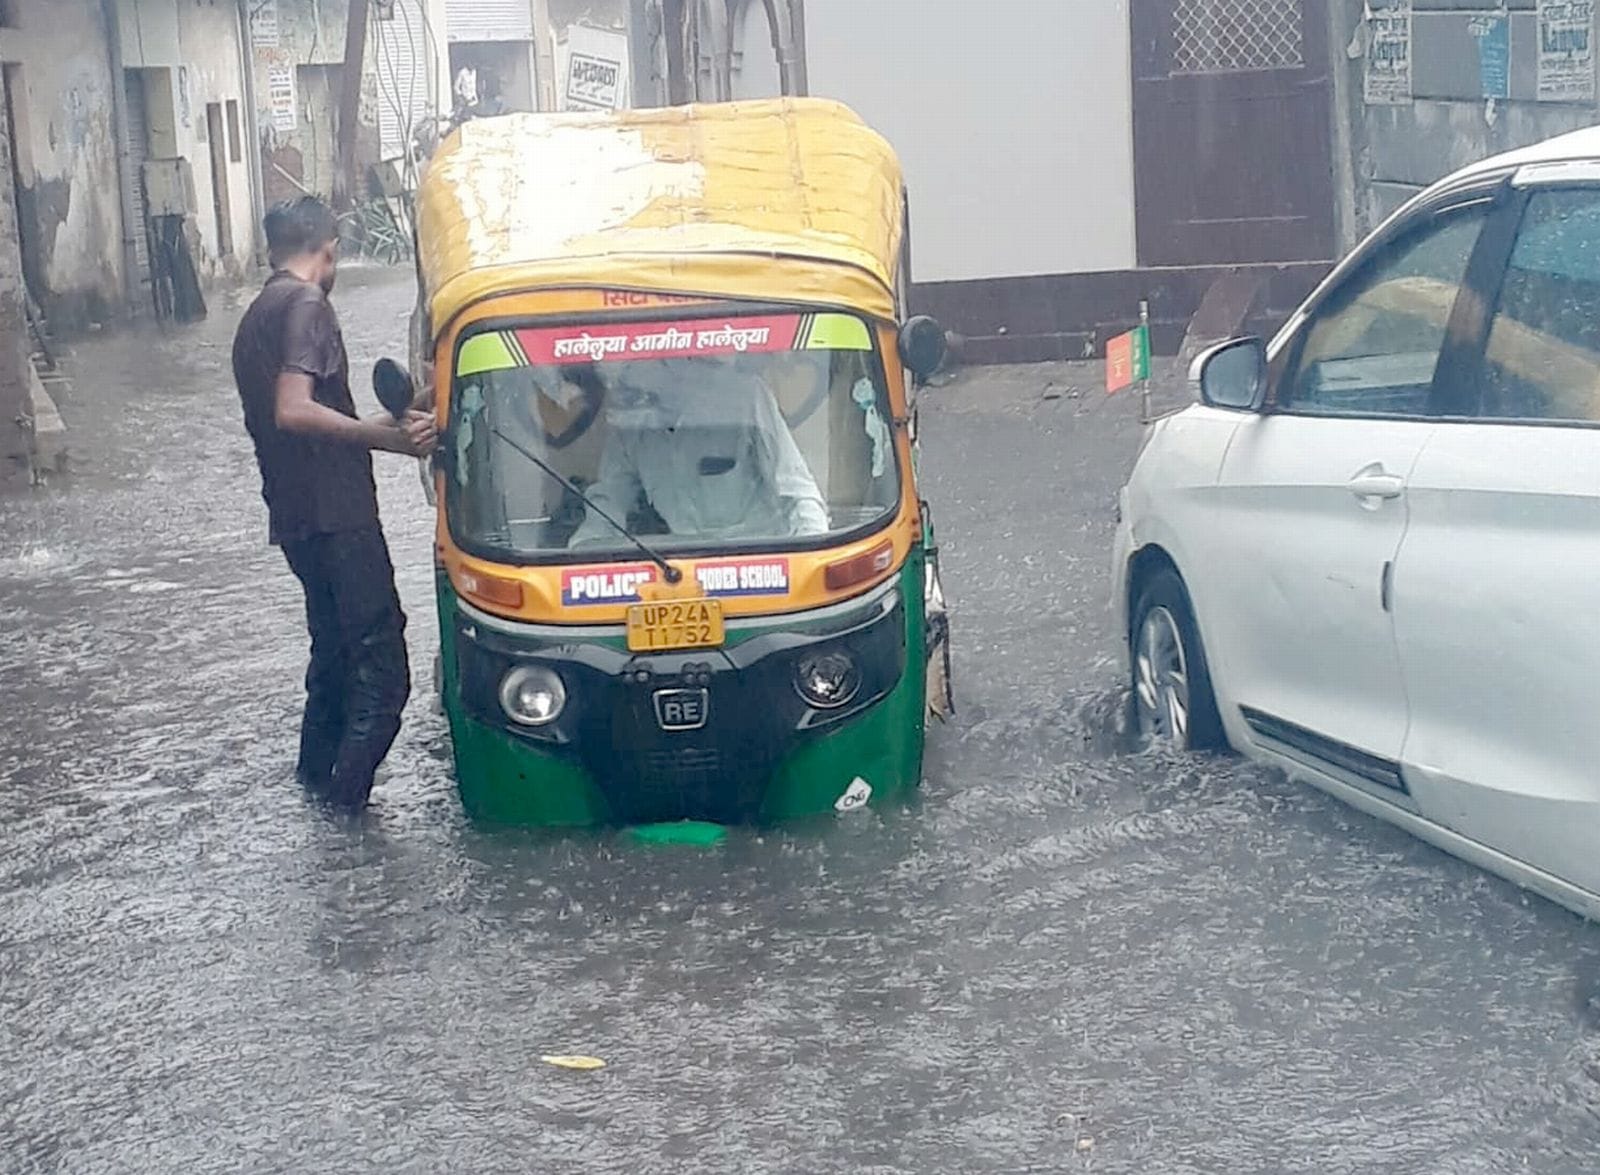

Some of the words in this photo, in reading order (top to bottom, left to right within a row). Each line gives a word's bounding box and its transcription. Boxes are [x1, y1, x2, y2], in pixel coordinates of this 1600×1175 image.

[740, 564, 787, 589] SCHOOL
[644, 603, 710, 625] UP24A
[645, 624, 711, 646] T1752
[664, 702, 699, 721] RE
